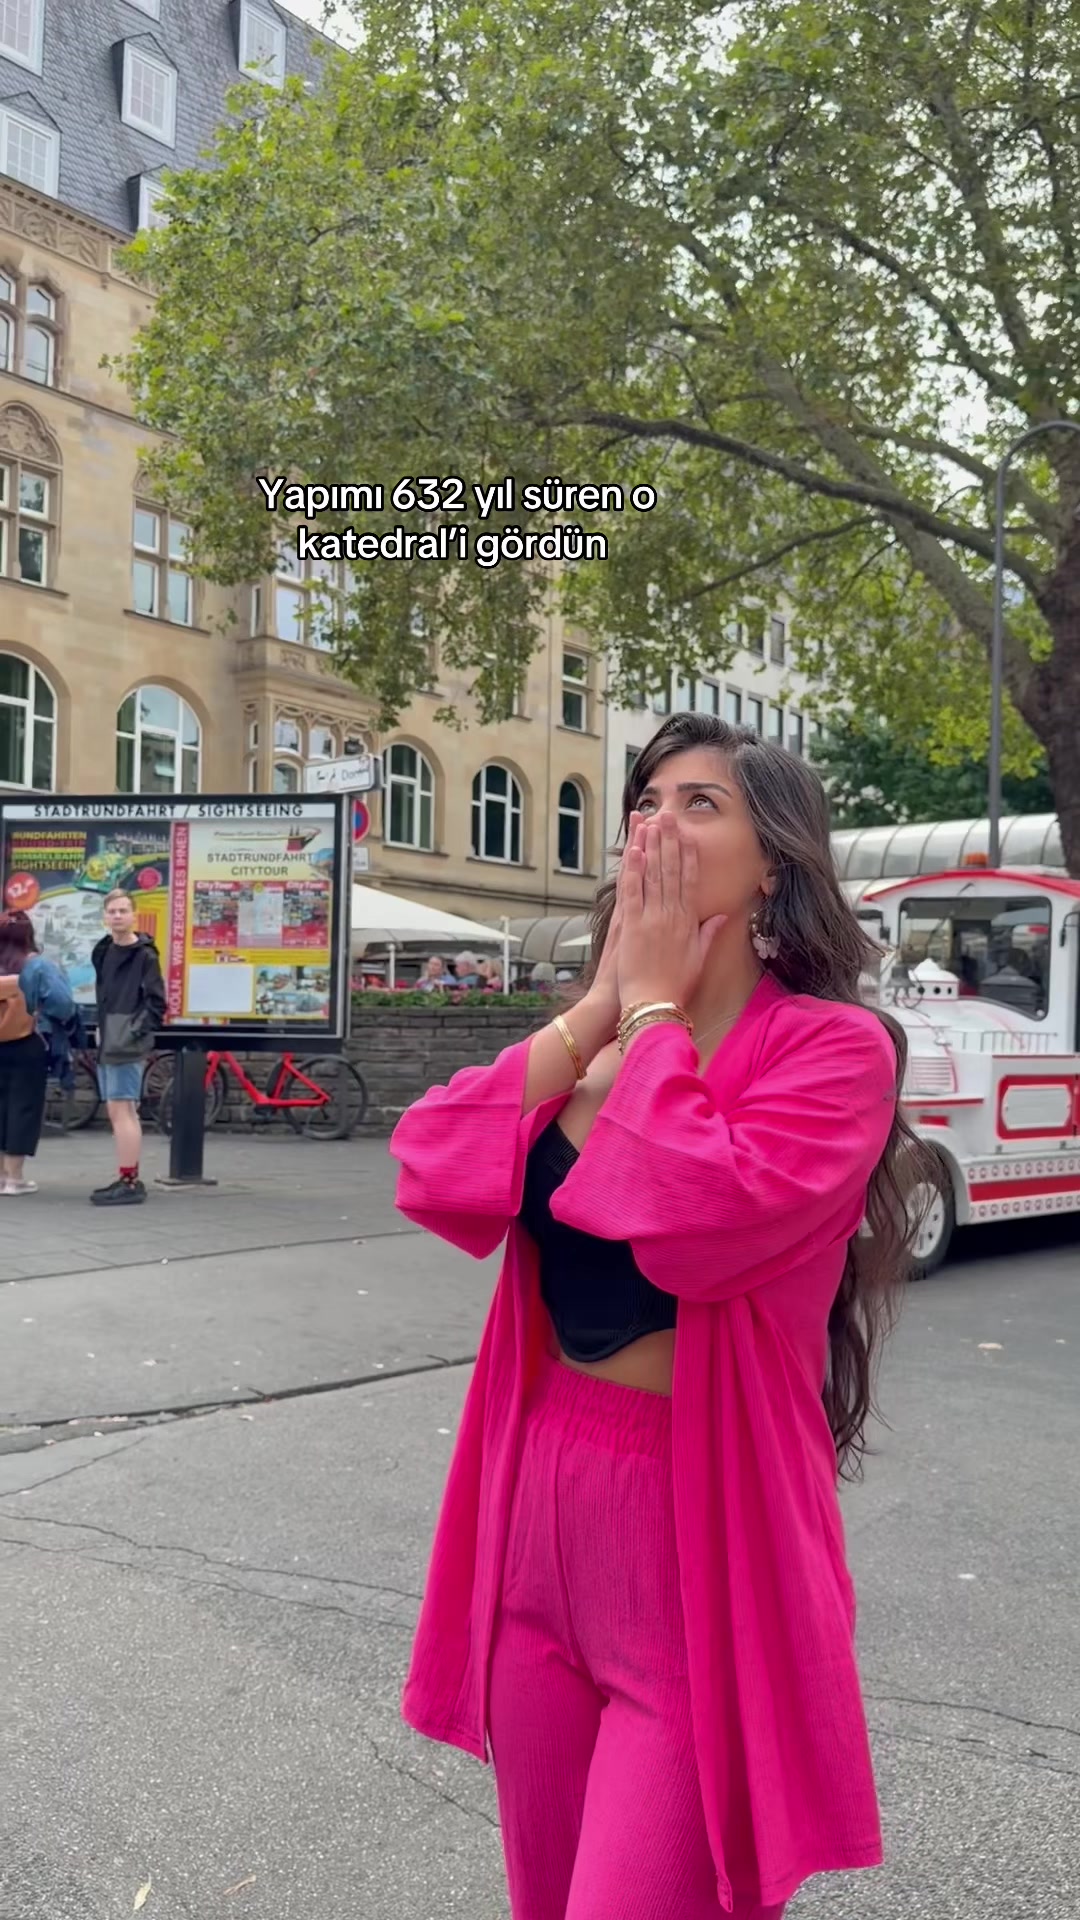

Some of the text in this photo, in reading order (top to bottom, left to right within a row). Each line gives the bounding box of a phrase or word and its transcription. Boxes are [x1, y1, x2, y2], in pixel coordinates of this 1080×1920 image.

[34, 803, 304, 818] STADTRUNDFAHRT / SIGHTSEEING
[175, 826, 187, 867] IHNEN
[207, 852, 312, 863] STADTRUNDFAHRT
[173, 869, 186, 887] ES
[231, 866, 289, 876] CITYTOUR
[173, 888, 186, 939] ZEIGEN
[172, 940, 184, 966] WIR
[168, 979, 182, 1016] KÖLN
